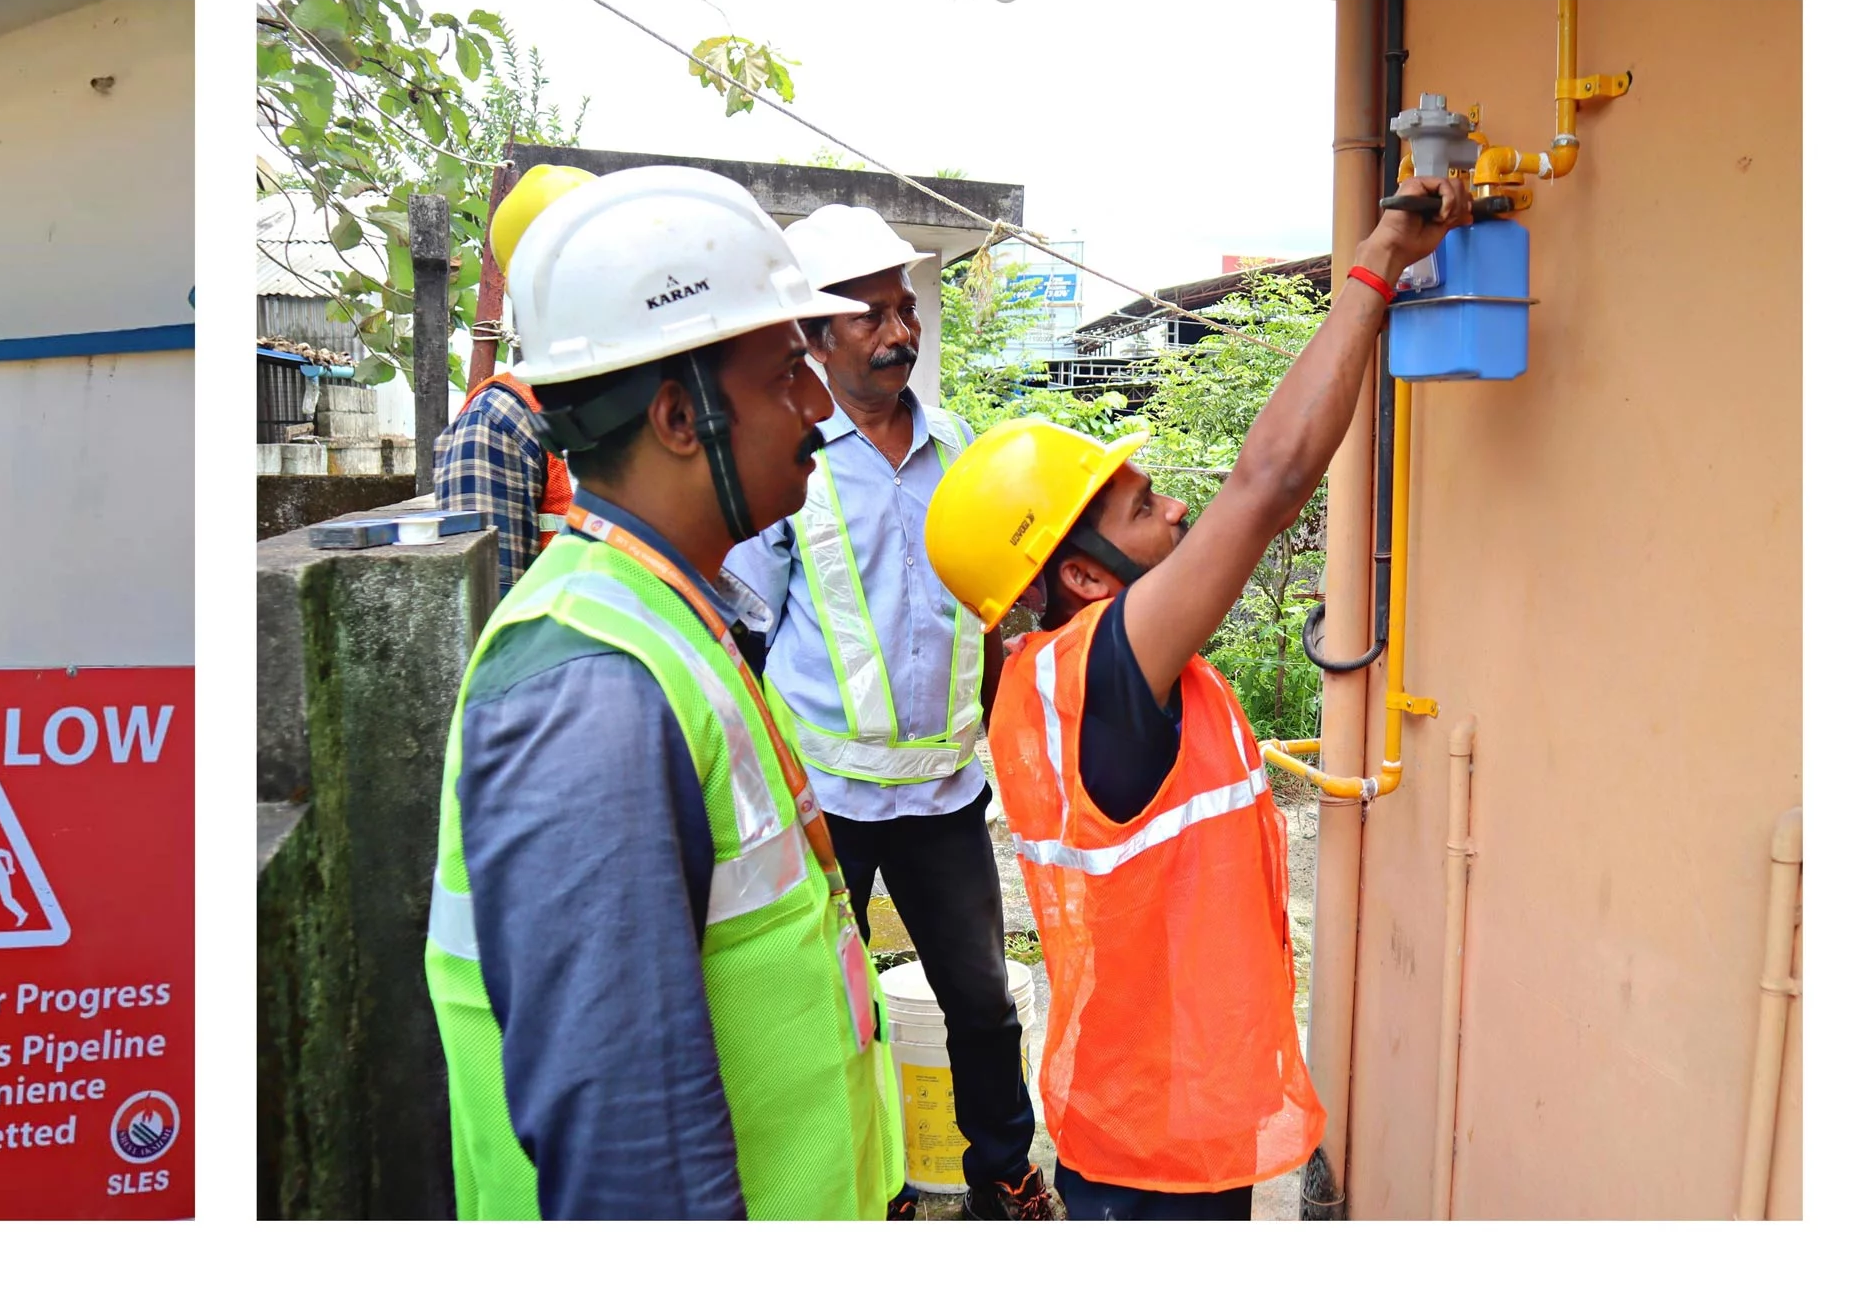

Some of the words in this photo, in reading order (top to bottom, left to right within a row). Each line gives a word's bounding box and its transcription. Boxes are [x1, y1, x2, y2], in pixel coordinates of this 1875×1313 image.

[645, 279, 710, 310] KARAM
[18, 984, 169, 1018] Progress
[21, 1030, 165, 1078] Pipeline
[107, 1169, 170, 1196] SLES
